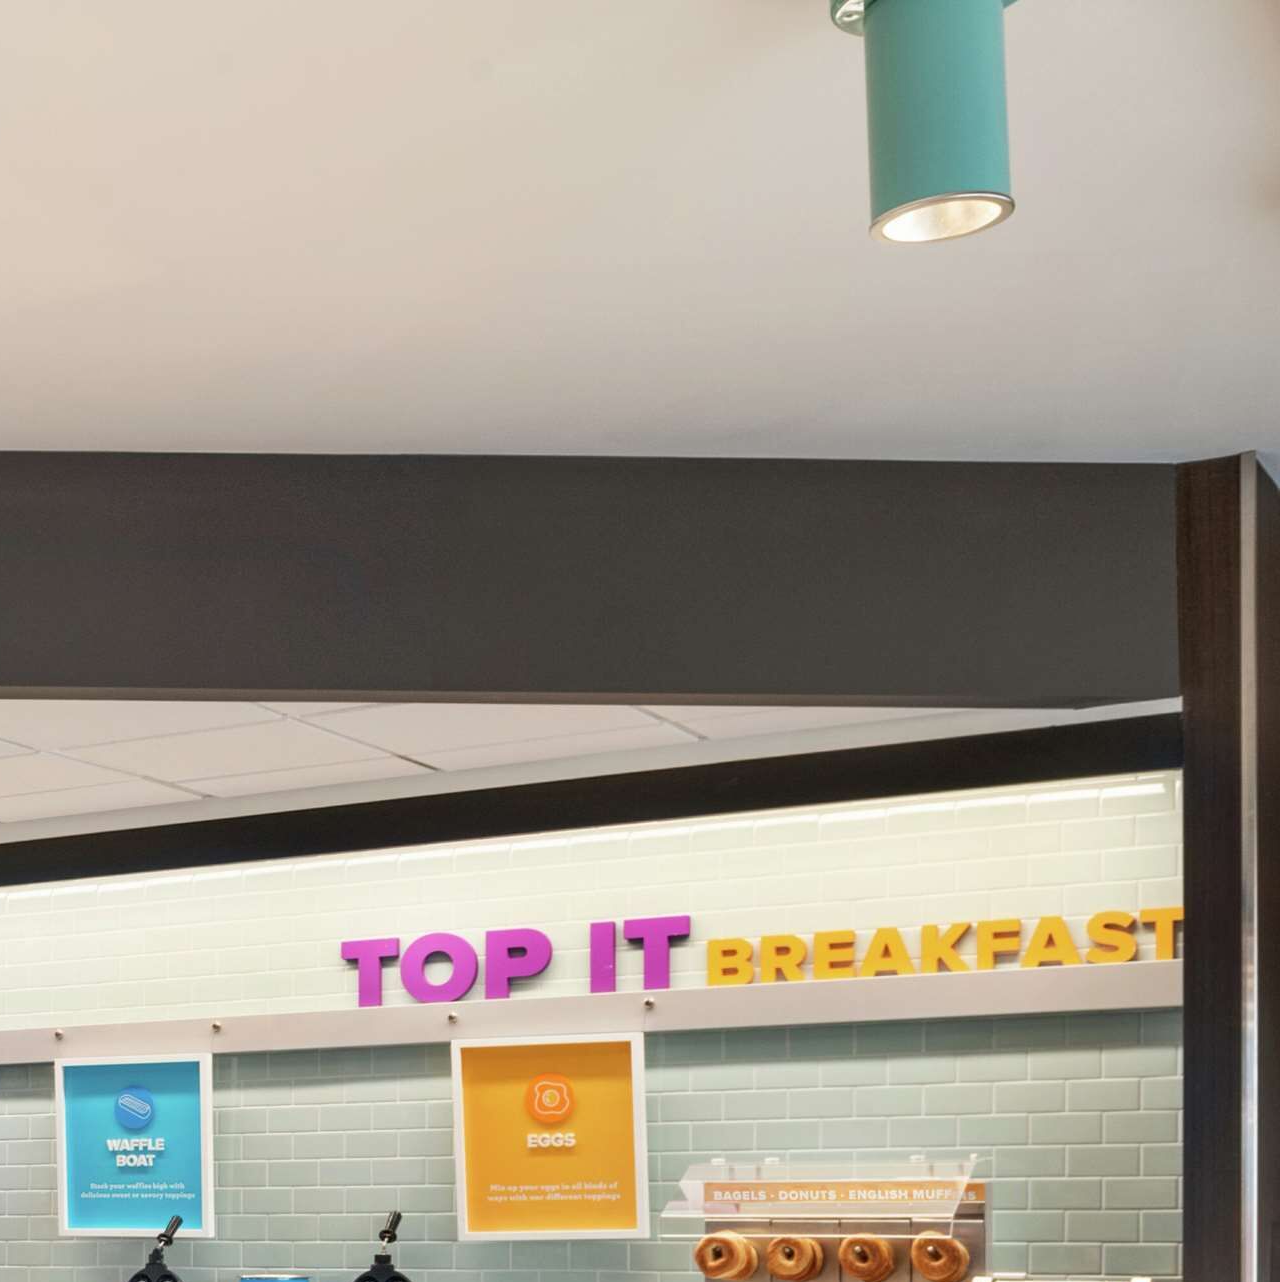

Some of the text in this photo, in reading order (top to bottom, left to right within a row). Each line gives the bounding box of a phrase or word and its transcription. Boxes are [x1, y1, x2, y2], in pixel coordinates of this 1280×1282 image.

[340, 906, 1184, 1007] TOP IT BREAKFAST
[106, 1138, 165, 1151] WAFFLE
[526, 1132, 577, 1148] EGGS
[116, 1154, 156, 1167] BOAT
[713, 1189, 767, 1201] BAGELS
[778, 1189, 837, 1201] DONUTS
[848, 1189, 908, 1201] ENGLISH
